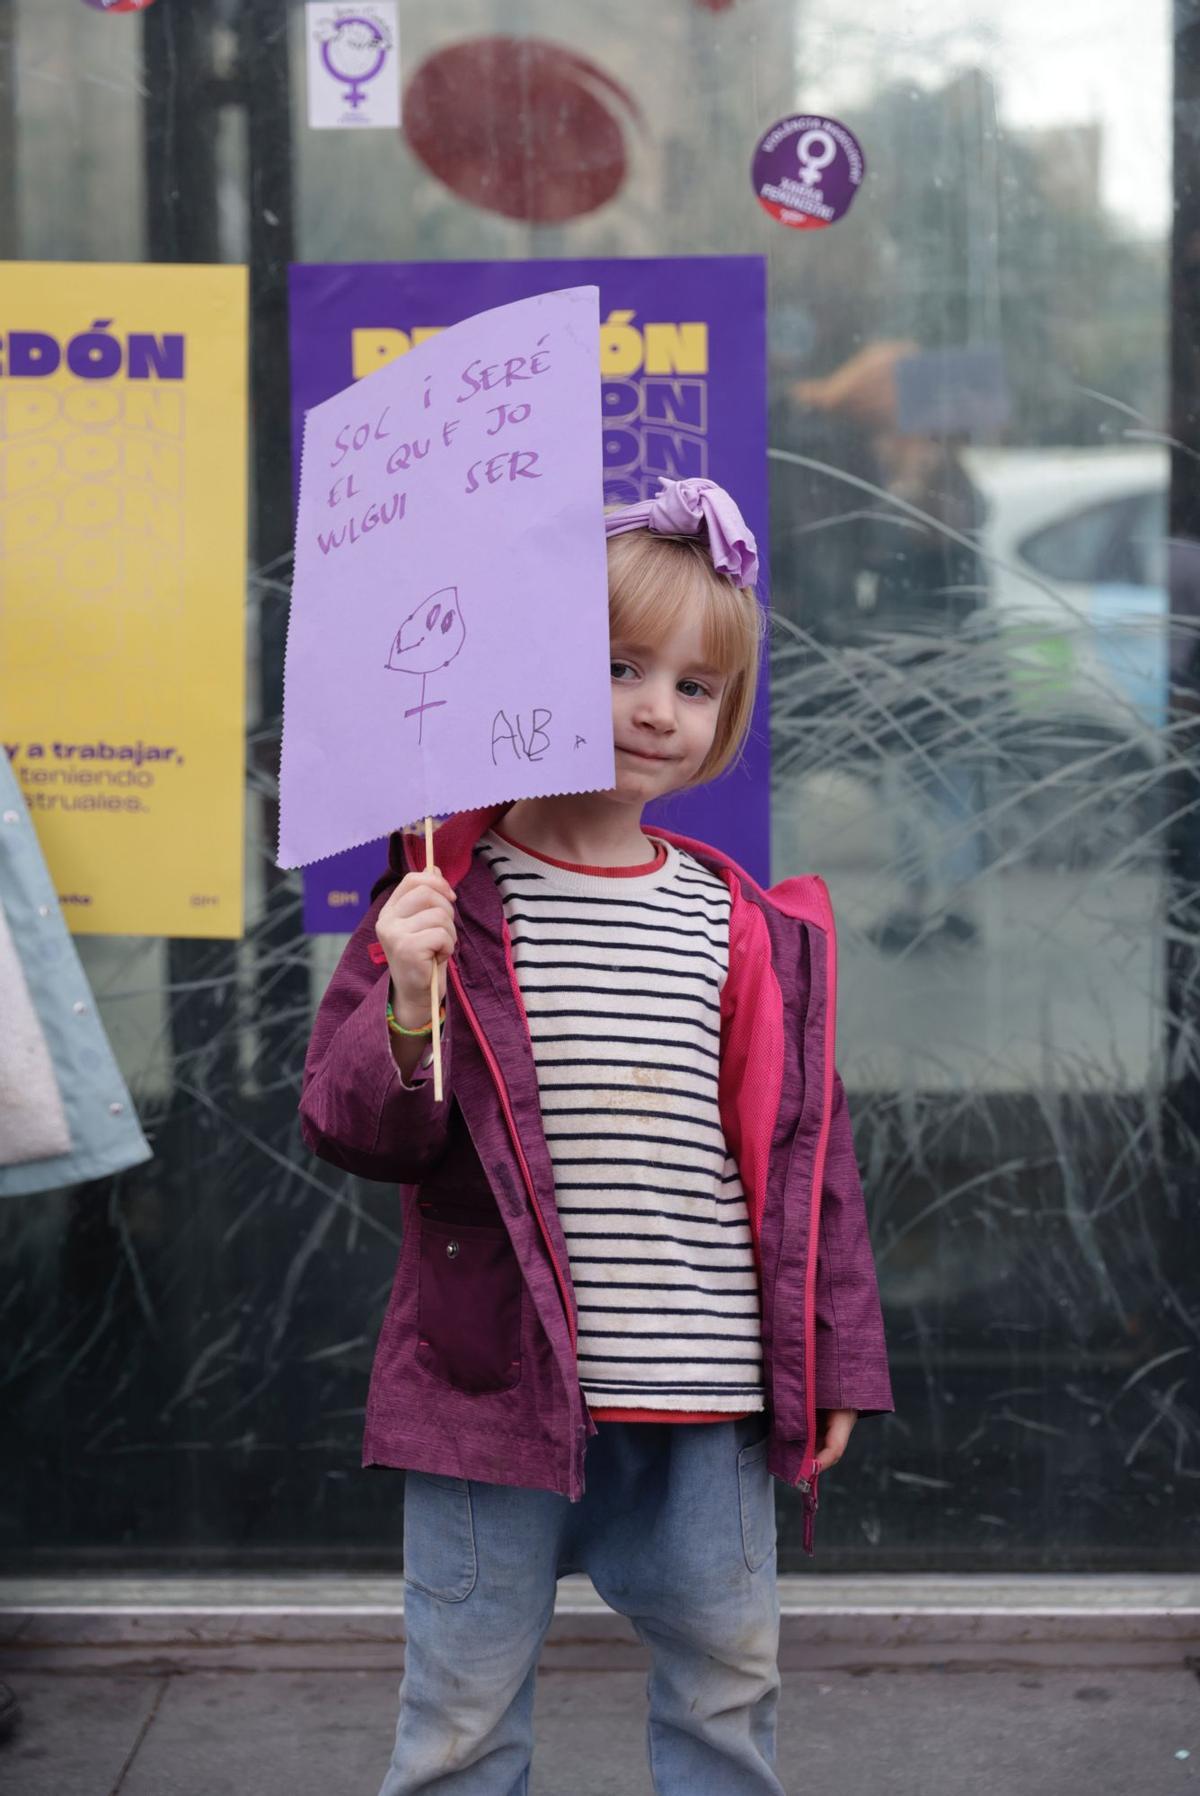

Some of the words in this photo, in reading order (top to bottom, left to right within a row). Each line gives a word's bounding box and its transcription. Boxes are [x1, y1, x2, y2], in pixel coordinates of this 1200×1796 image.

[0, 319, 184, 380] DÓN
[456, 333, 551, 403] SERÉ
[328, 474, 360, 507] EL
[485, 403, 531, 436] JO
[465, 451, 543, 494] SER
[27, 743, 45, 760] a
